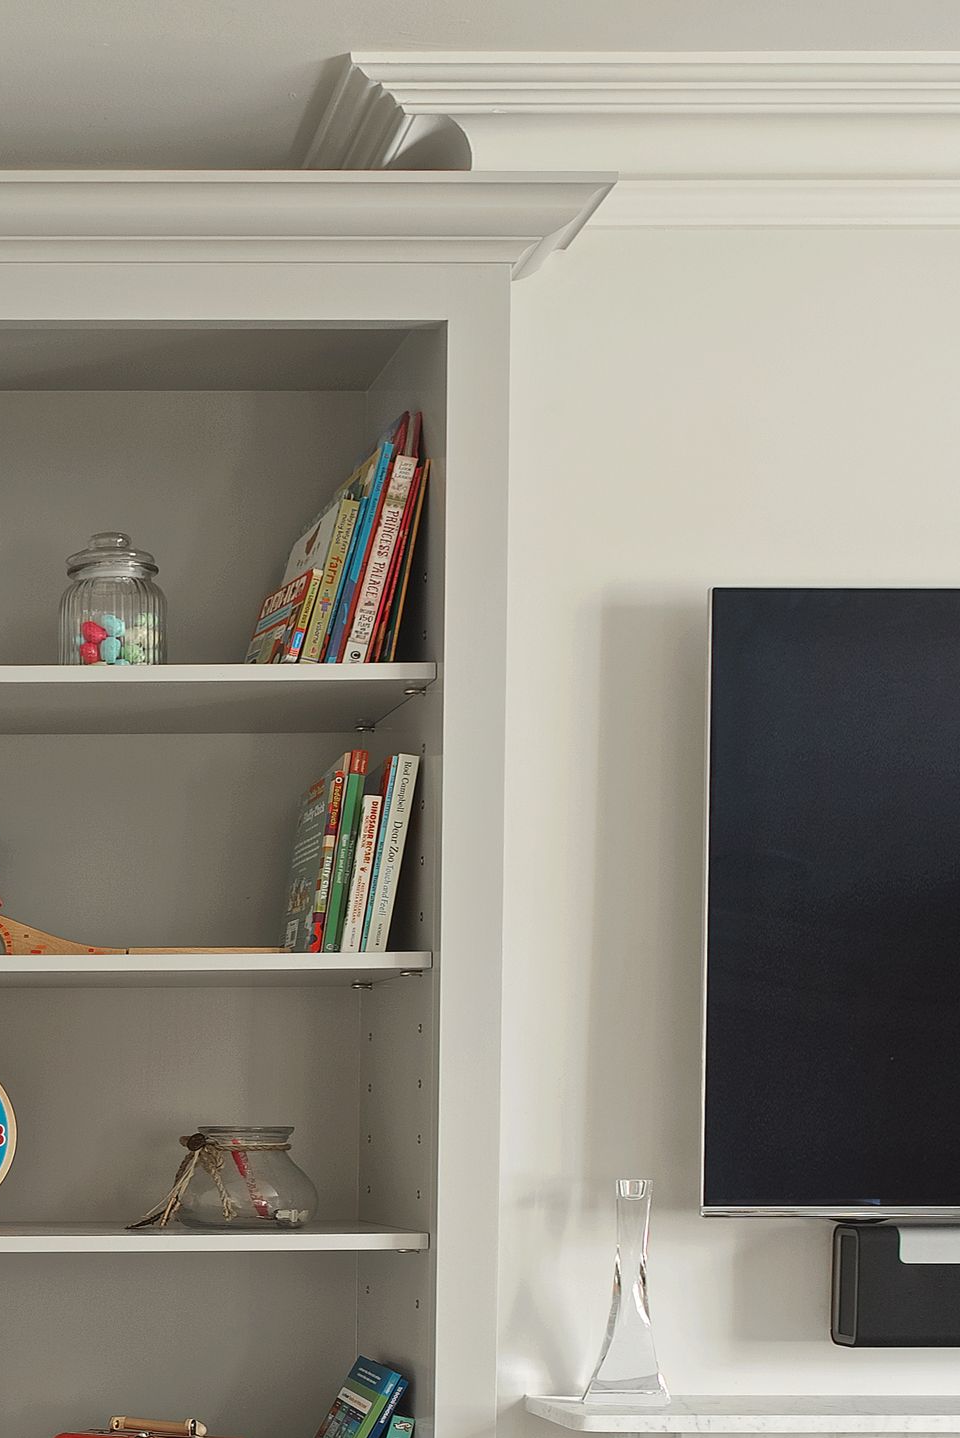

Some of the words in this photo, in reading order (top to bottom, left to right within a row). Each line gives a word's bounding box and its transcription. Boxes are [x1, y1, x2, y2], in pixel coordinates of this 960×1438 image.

[377, 509, 399, 559] PRINCESS
[324, 554, 343, 586] farm
[365, 560, 385, 599] PALACE
[402, 761, 412, 776] Rod
[331, 785, 342, 808] Toddler
[395, 777, 410, 812] Campbell
[330, 808, 339, 826] Touch
[366, 801, 380, 839] DINOSAUR
[390, 821, 403, 844] Dear
[363, 841, 373, 864] ROAR!
[387, 846, 399, 863] Zoo
[384, 865, 394, 885] Touch
[381, 885, 391, 899] and
